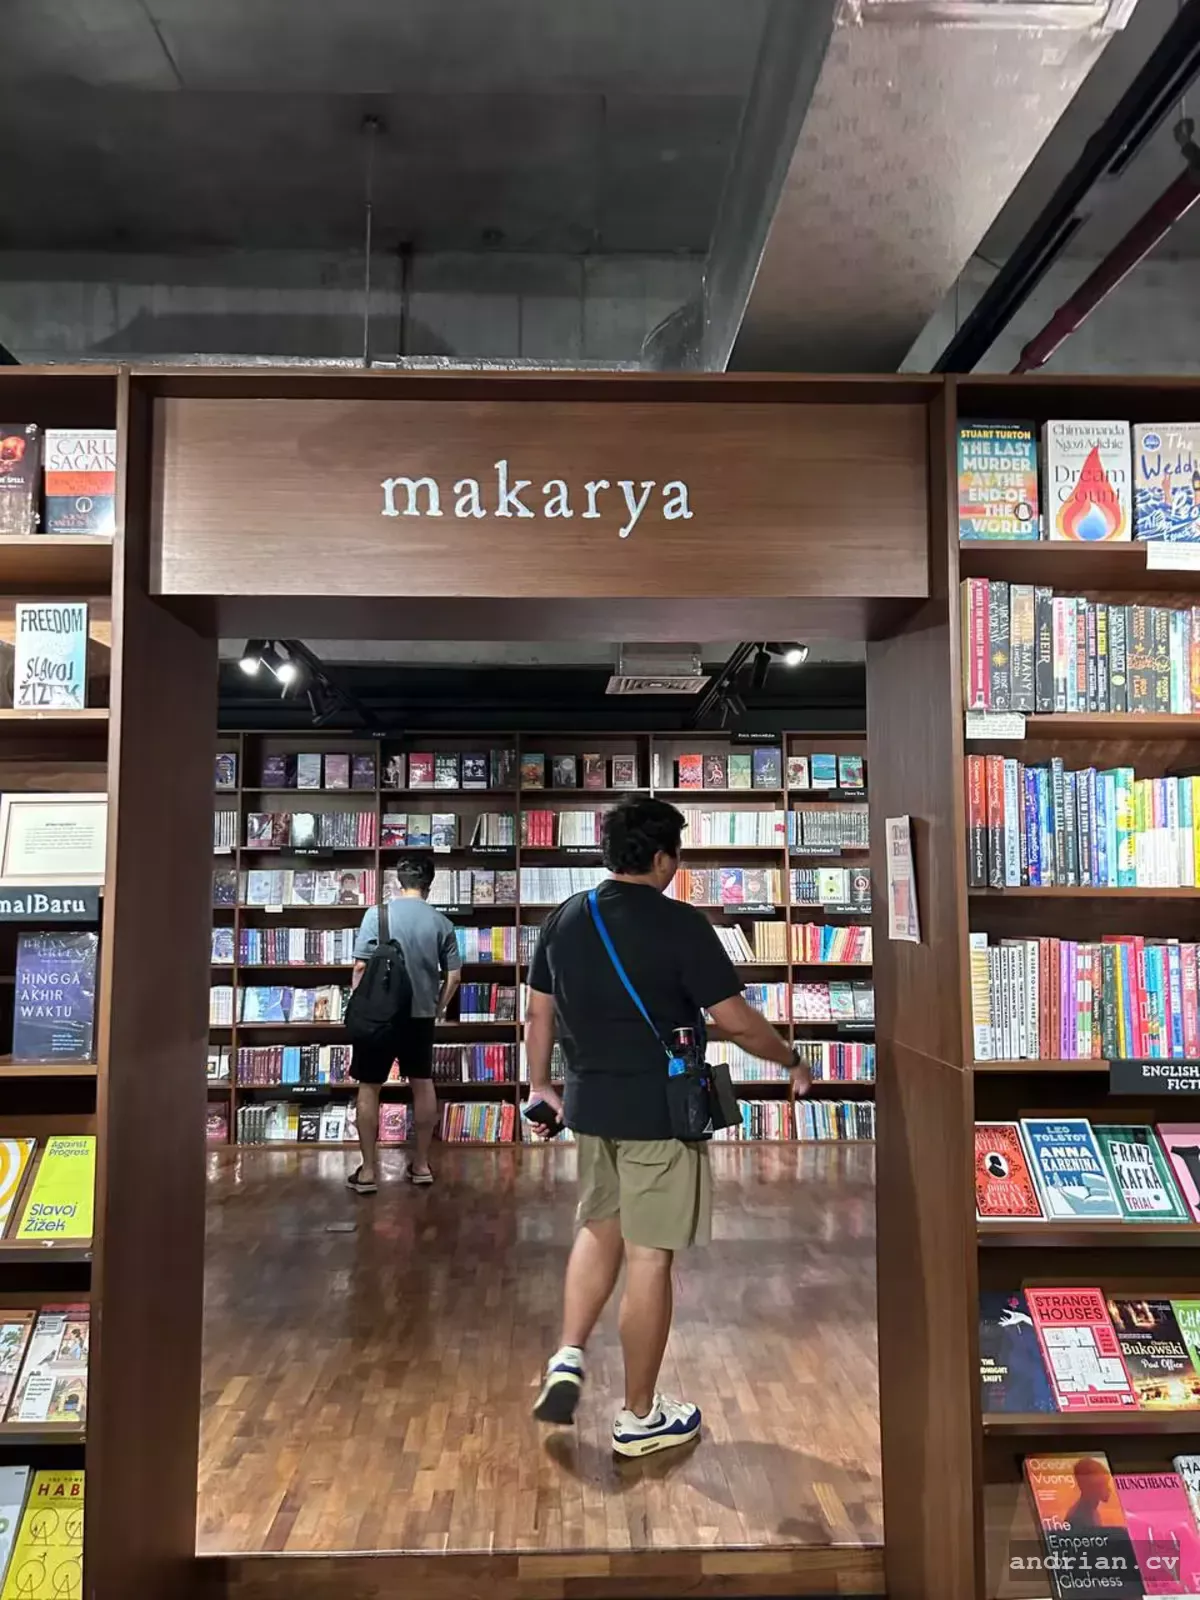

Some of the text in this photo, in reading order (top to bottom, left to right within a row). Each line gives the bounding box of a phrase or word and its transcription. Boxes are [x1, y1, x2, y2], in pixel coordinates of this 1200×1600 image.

[961, 430, 1031, 439] STUART TURTON
[1166, 433, 1193, 450] The
[57, 440, 113, 455] CARL
[961, 441, 1031, 456] THE LAST
[963, 457, 1031, 471] MURDER
[993, 472, 1024, 487] THE
[1055, 465, 1125, 483] Dream
[381, 459, 694, 538] makarya
[969, 487, 1027, 502] END OF
[984, 504, 1013, 517] THE
[971, 518, 1033, 533] WORLD
[21, 608, 83, 634] FREEDOM
[1038, 631, 1050, 665] HEIR
[26, 656, 74, 681] SLAVOJ
[1022, 651, 1032, 690] MANY
[22, 973, 80, 985] HINGGA
[21, 989, 63, 1001] AKHIR
[21, 1006, 72, 1017] WAKTU
[1142, 1065, 1200, 1077] ENGLISH
[1167, 1079, 1200, 1090] FICT
[1046, 1126, 1069, 1134] LEO
[51, 1141, 87, 1149] Against
[1034, 1134, 1087, 1142] TOLSTOY
[49, 1149, 89, 1157] Progress
[1040, 1147, 1093, 1158] ANNA
[1110, 1143, 1153, 1165] FRANZ
[1043, 1159, 1101, 1172] KARENINA
[1115, 1165, 1163, 1190] KAFKA
[987, 1192, 1028, 1207] GRAY
[1126, 1197, 1154, 1209] TRIAL
[29, 1202, 78, 1217] Slavoj
[24, 1217, 66, 1232] Žižek
[1035, 1296, 1098, 1307] STRANGE
[1039, 1308, 1104, 1320] HOUSES
[1121, 1342, 1184, 1355] Bukowski
[1161, 1358, 1184, 1371] Office
[1032, 1472, 1075, 1489] Vuong
[1115, 1477, 1180, 1490] HUNCHBACK
[1043, 1515, 1072, 1531] The
[1048, 1535, 1109, 1552] Emperor
[1060, 1571, 1124, 1588] Gladness
